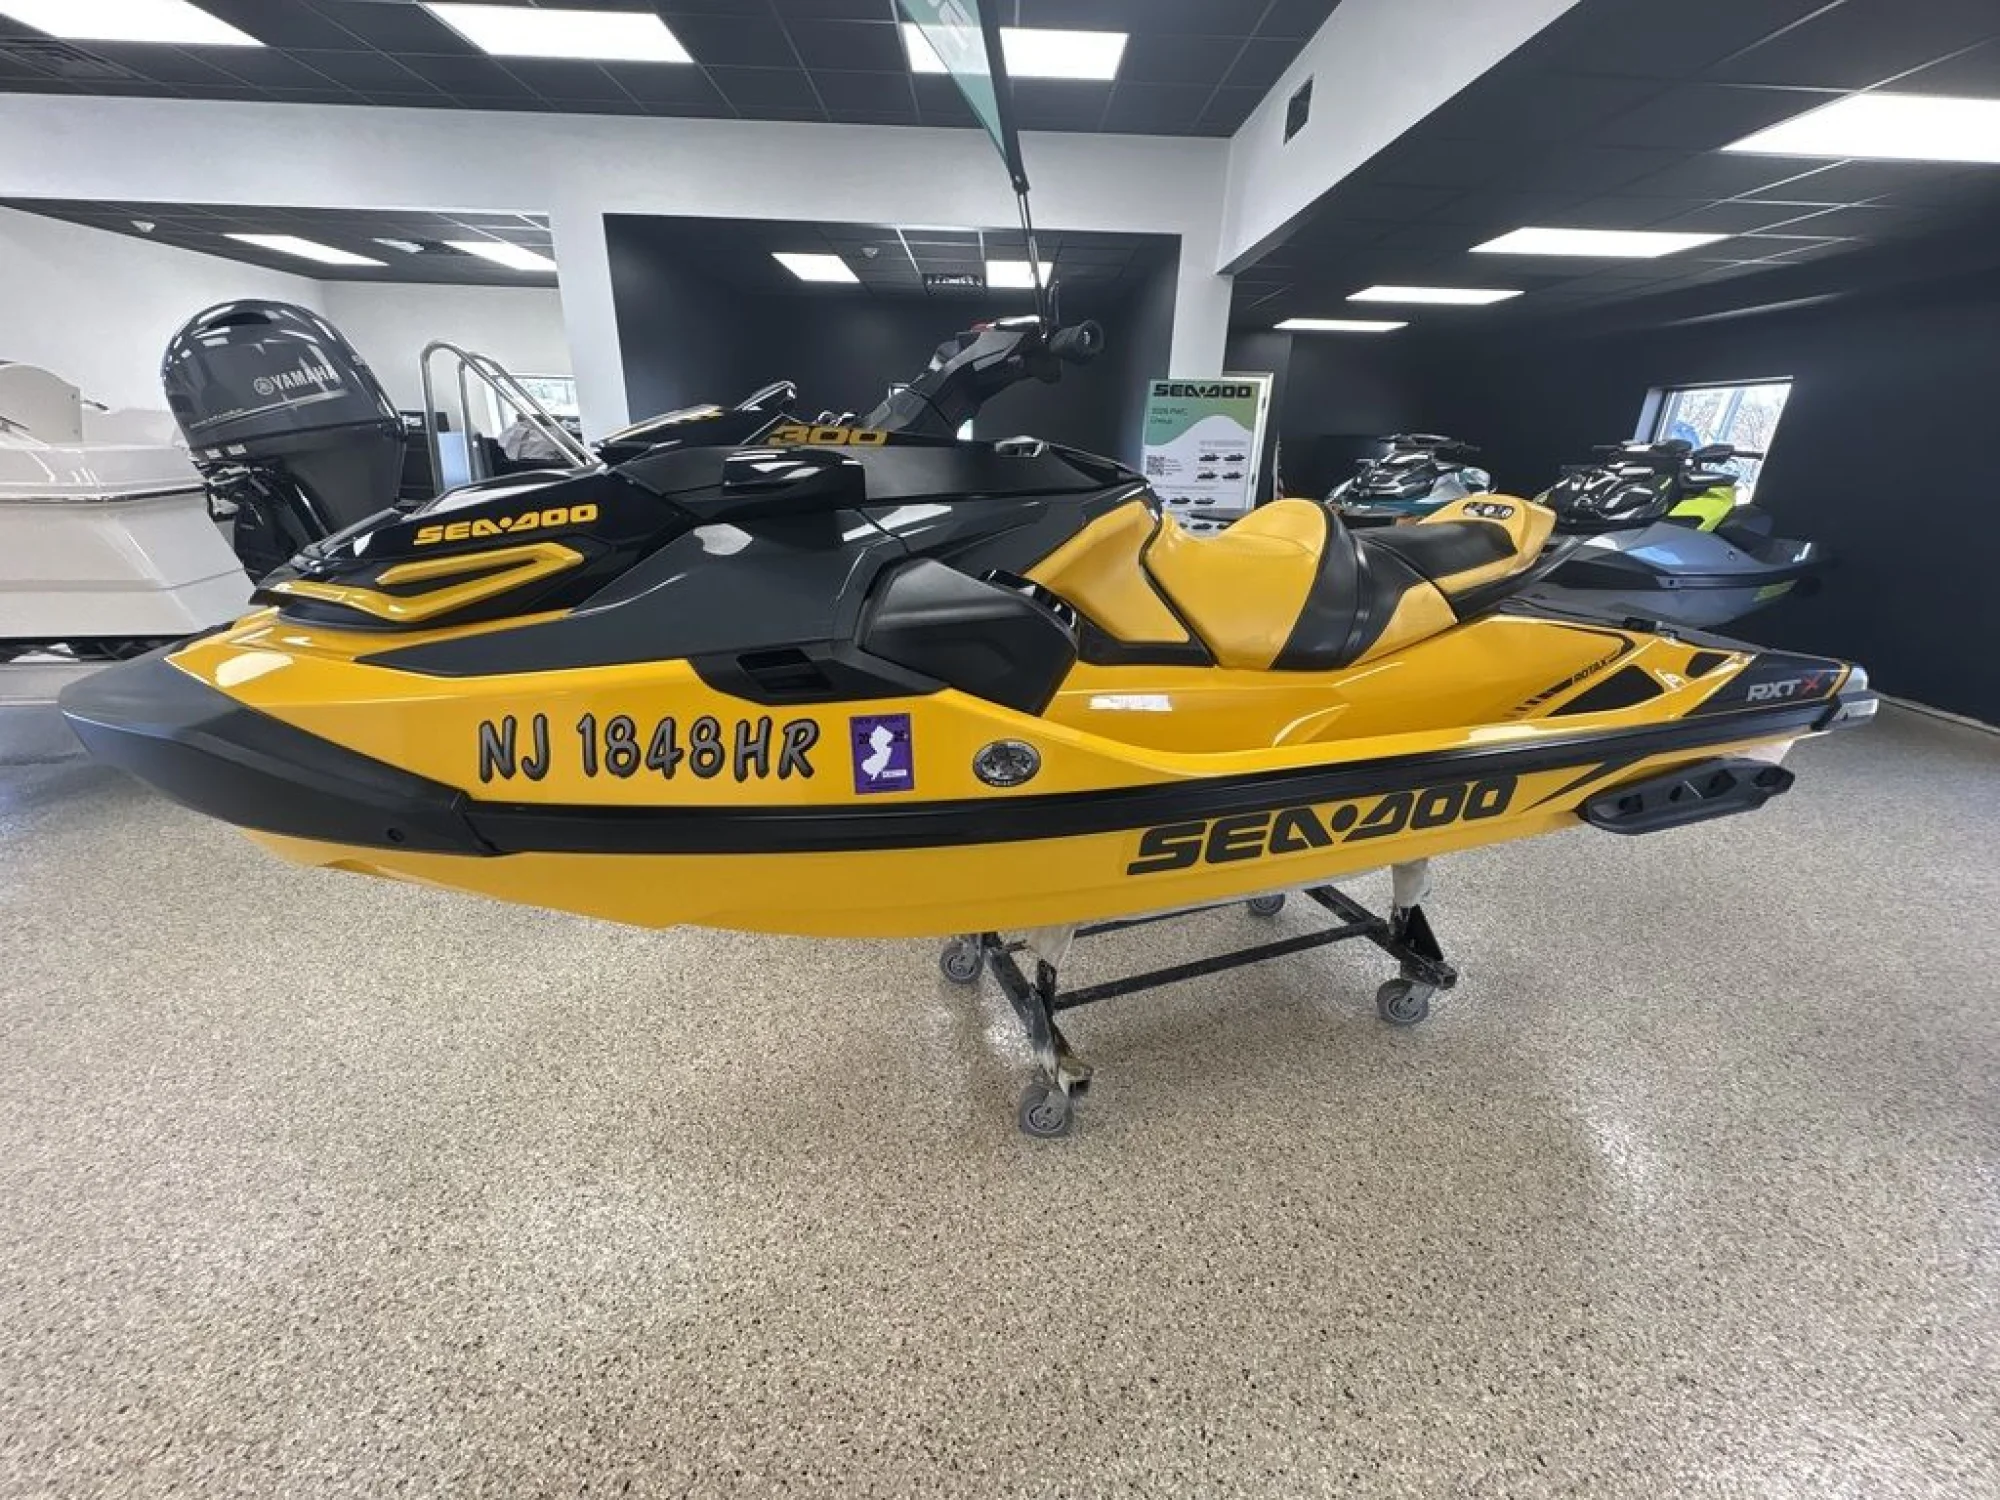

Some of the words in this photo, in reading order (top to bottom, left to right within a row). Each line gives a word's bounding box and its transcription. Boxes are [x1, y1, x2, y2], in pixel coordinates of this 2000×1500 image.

[270, 365, 340, 390] YAMAHA
[767, 425, 888, 446] 300
[1572, 658, 1610, 683] ROTAX
[1746, 679, 1802, 702] RXT
[478, 713, 550, 784] NJ
[575, 712, 821, 784] 1848HR
